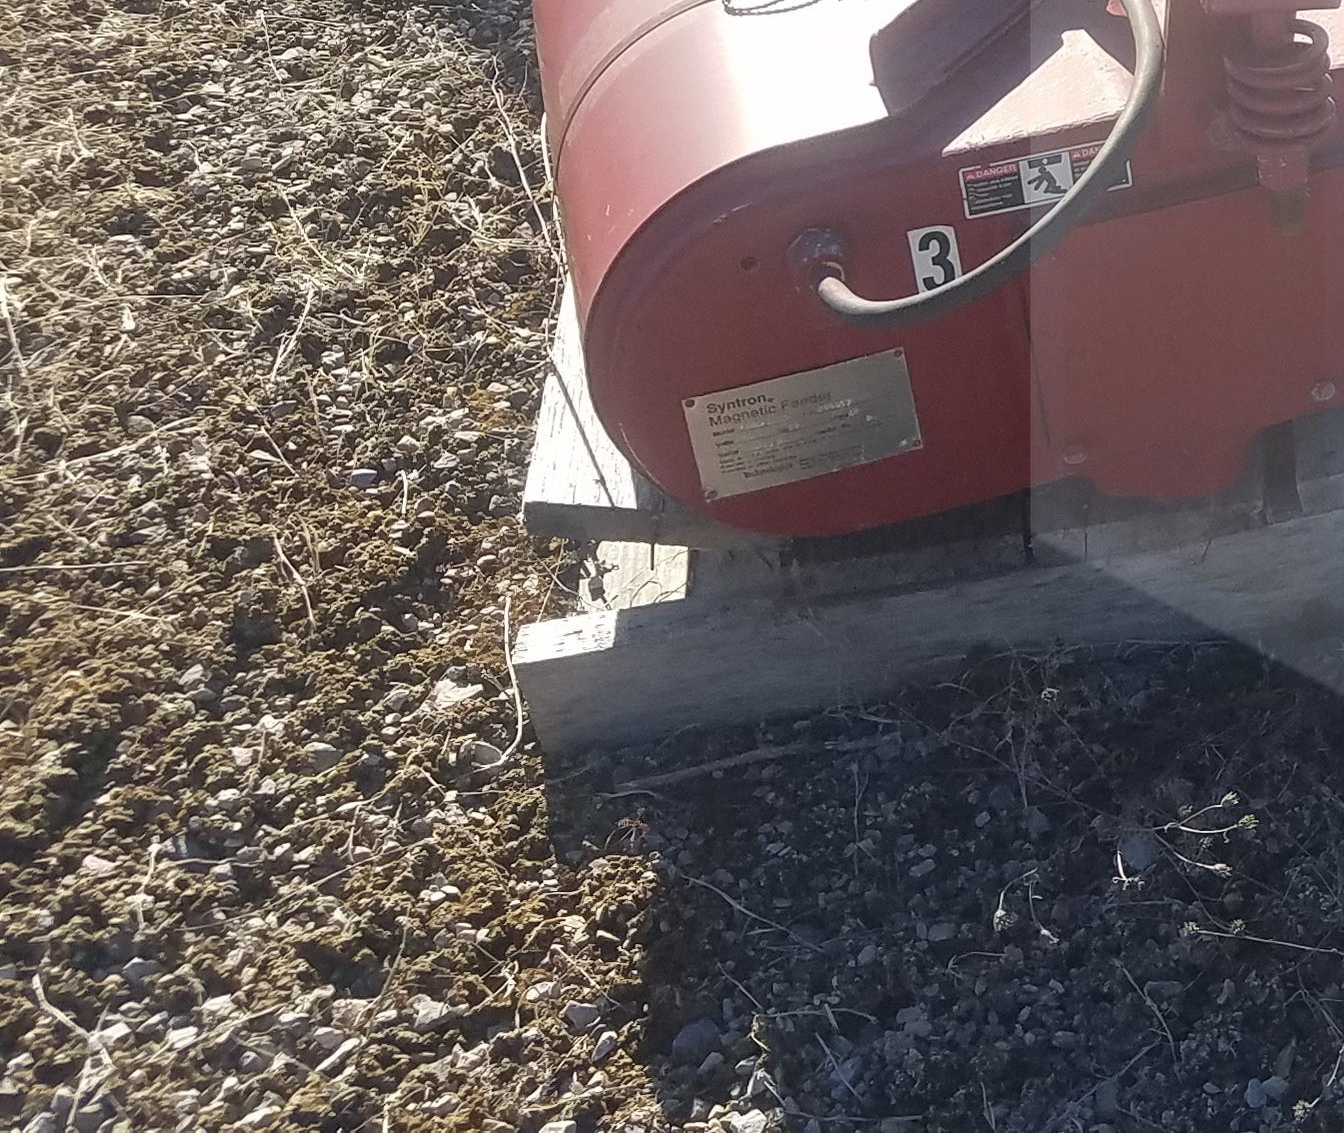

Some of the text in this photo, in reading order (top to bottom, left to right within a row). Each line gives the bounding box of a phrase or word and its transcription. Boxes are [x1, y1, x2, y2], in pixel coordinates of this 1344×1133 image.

[976, 164, 1017, 178] DANGER
[918, 231, 956, 291] 3
[708, 405, 777, 427] Magnetic
